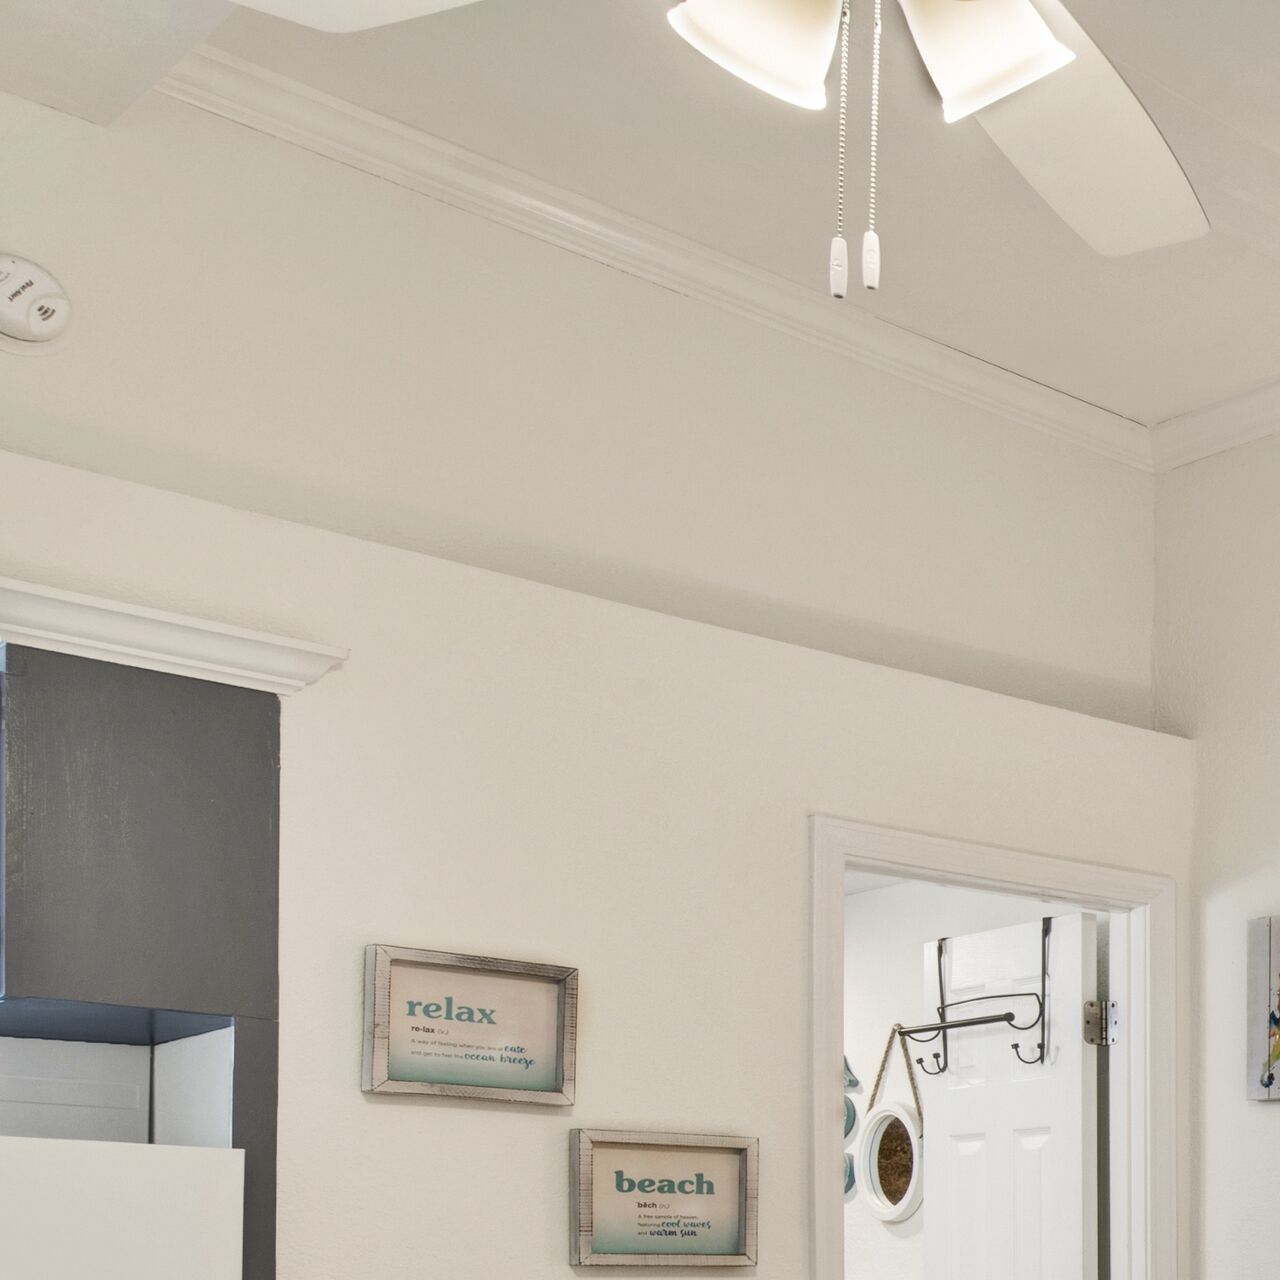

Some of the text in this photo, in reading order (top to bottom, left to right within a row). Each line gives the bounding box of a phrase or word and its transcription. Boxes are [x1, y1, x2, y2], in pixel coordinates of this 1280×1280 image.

[406, 996, 497, 1025] relax
[464, 1053, 495, 1062] ocean
[500, 1054, 535, 1069] breeze
[614, 1170, 715, 1195] beach
[661, 1220, 680, 1228] cool
[683, 1220, 711, 1230] waves
[649, 1229, 677, 1237] warm
[680, 1229, 697, 1238] sun
